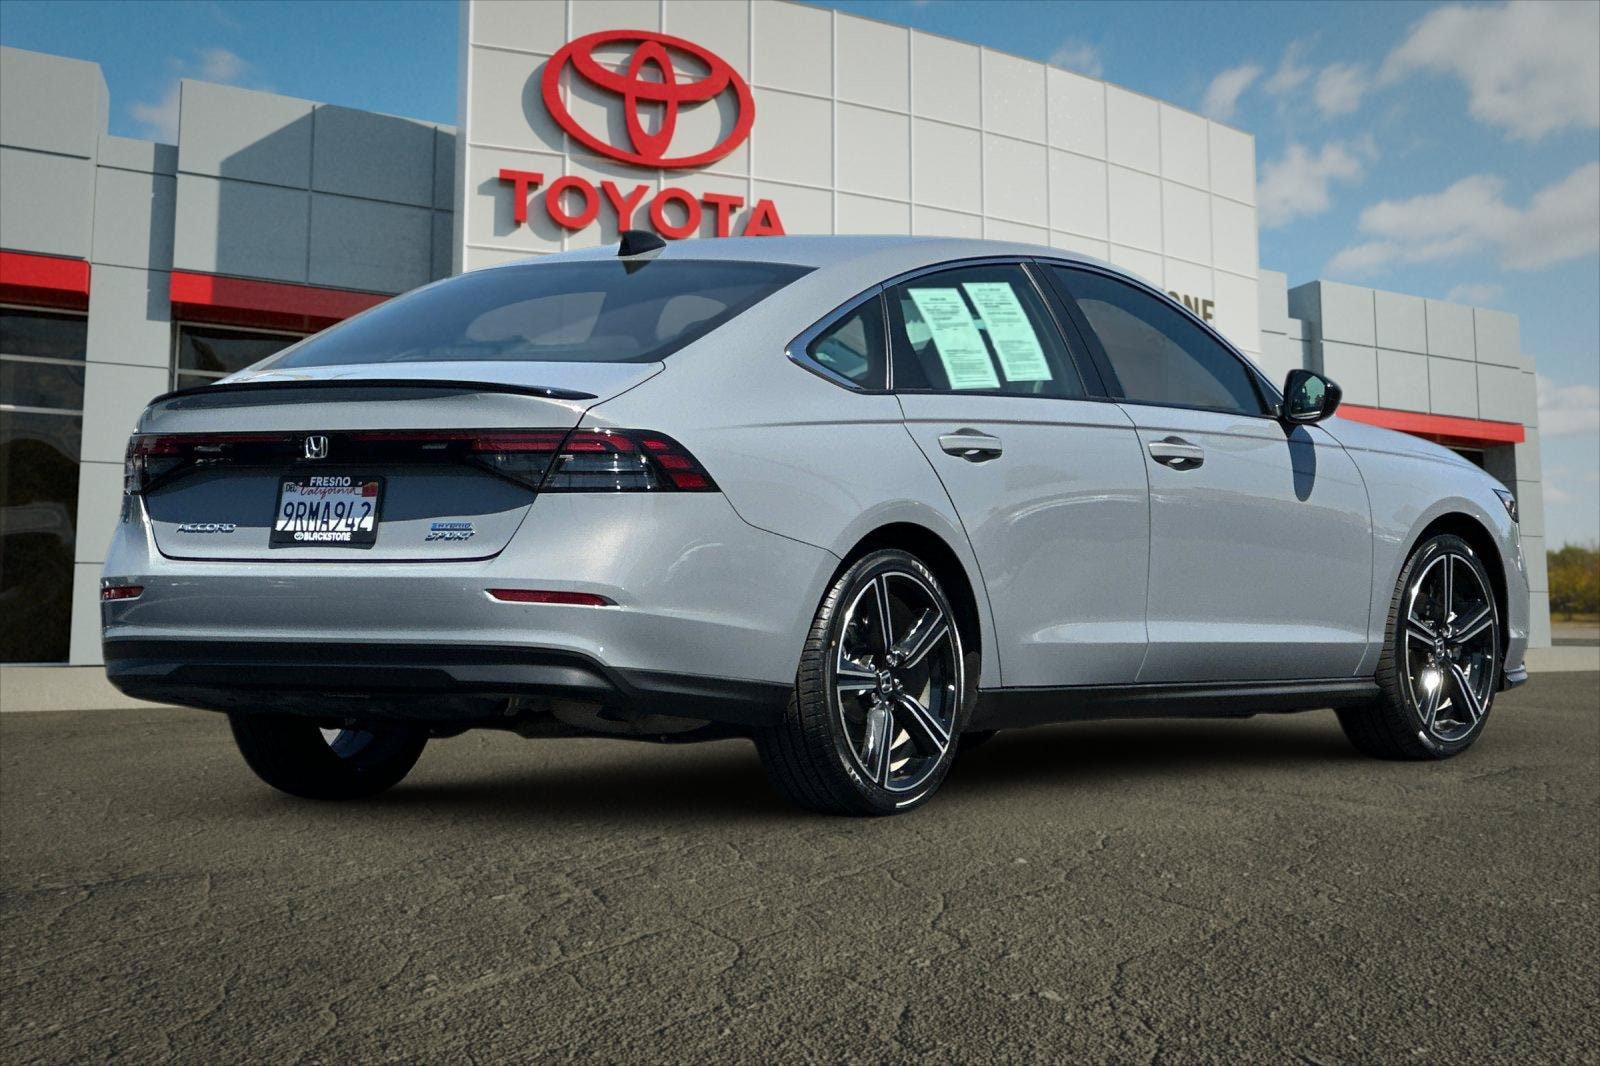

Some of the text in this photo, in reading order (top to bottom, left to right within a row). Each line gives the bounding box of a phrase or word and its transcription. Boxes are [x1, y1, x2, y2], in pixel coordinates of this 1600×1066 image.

[499, 169, 785, 240] TOYOTA
[310, 476, 351, 486] FRESNO
[280, 501, 372, 531] 9RMA942
[176, 523, 236, 533] ACCORD
[303, 531, 352, 541] BLACKSTONE
[425, 530, 475, 541] SPORT
